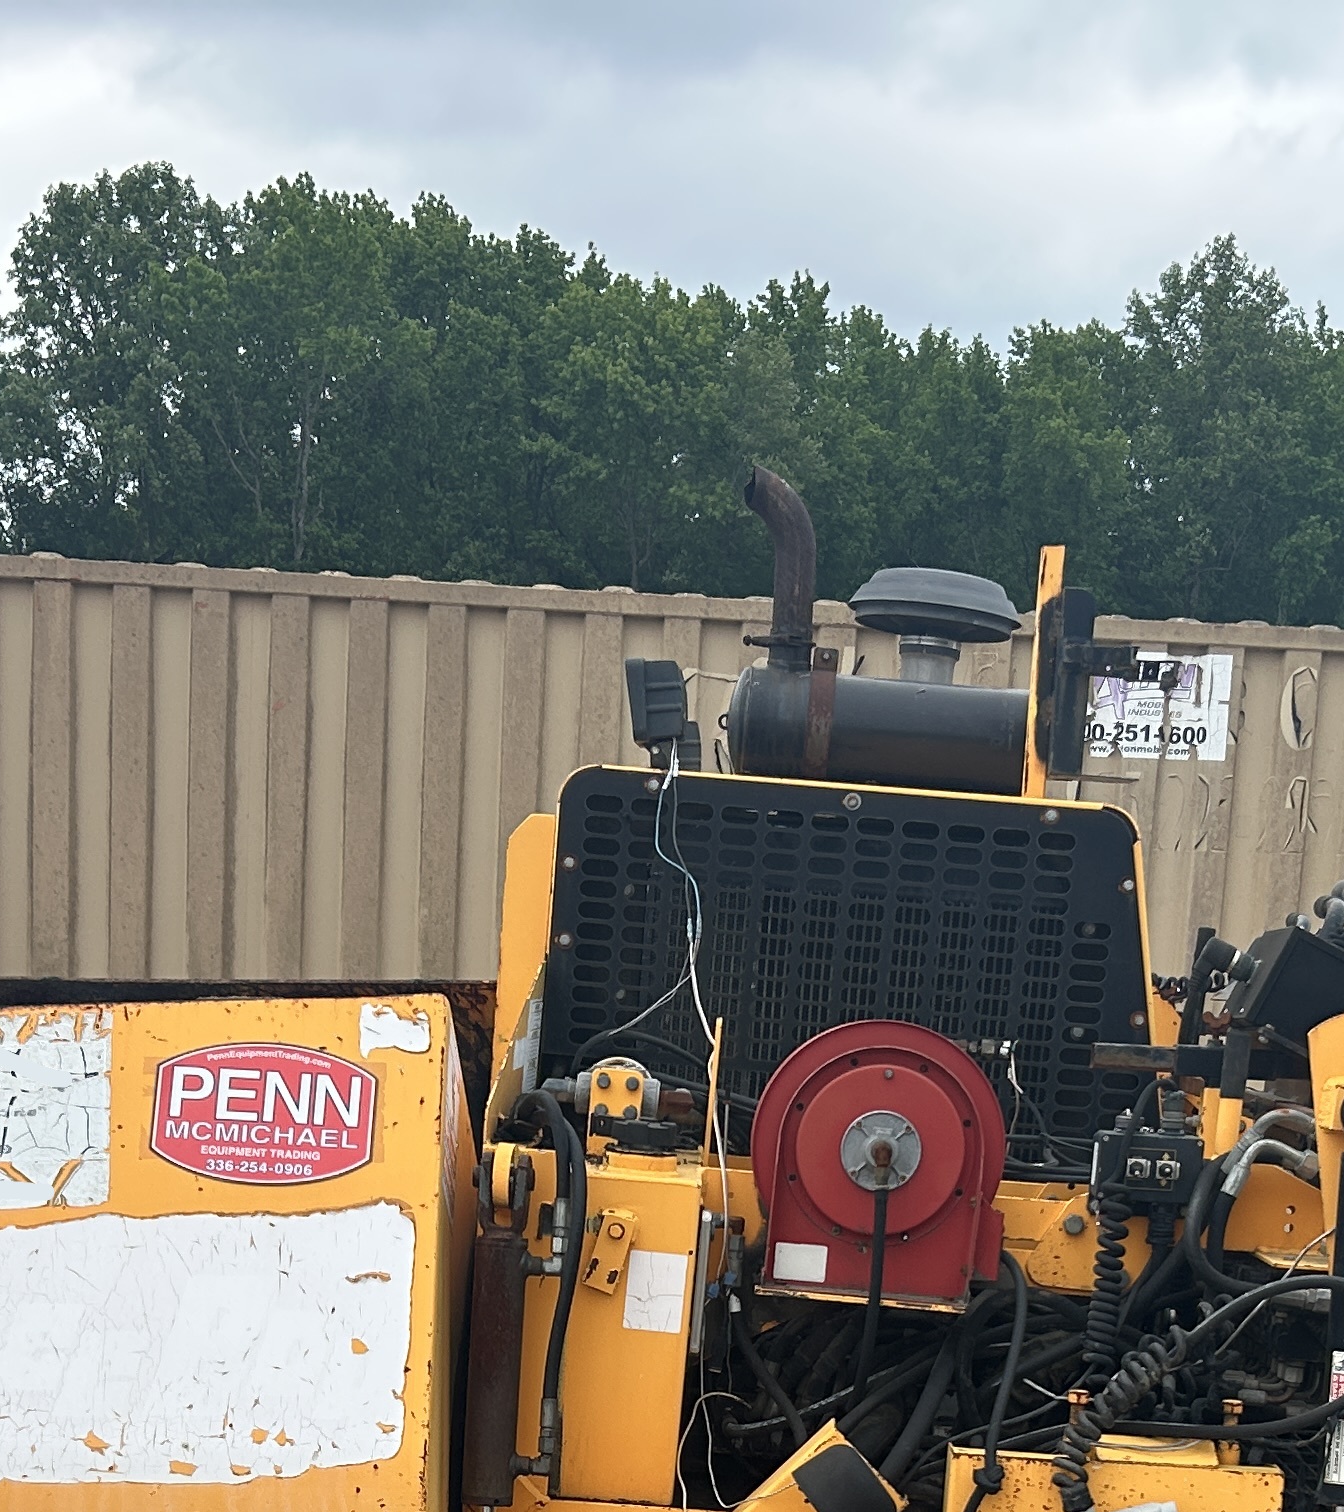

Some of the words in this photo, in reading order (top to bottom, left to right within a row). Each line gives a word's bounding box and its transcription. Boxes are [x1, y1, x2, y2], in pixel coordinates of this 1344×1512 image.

[206, 1049, 331, 1069] PennEquipmentTrading.com
[168, 1065, 363, 1128] PENN
[165, 1120, 358, 1149] MCMICHAEL
[200, 1145, 268, 1158] EQUIPMENT
[270, 1148, 321, 1161] TRADING
[206, 1159, 313, 1176] 336-254-0906
